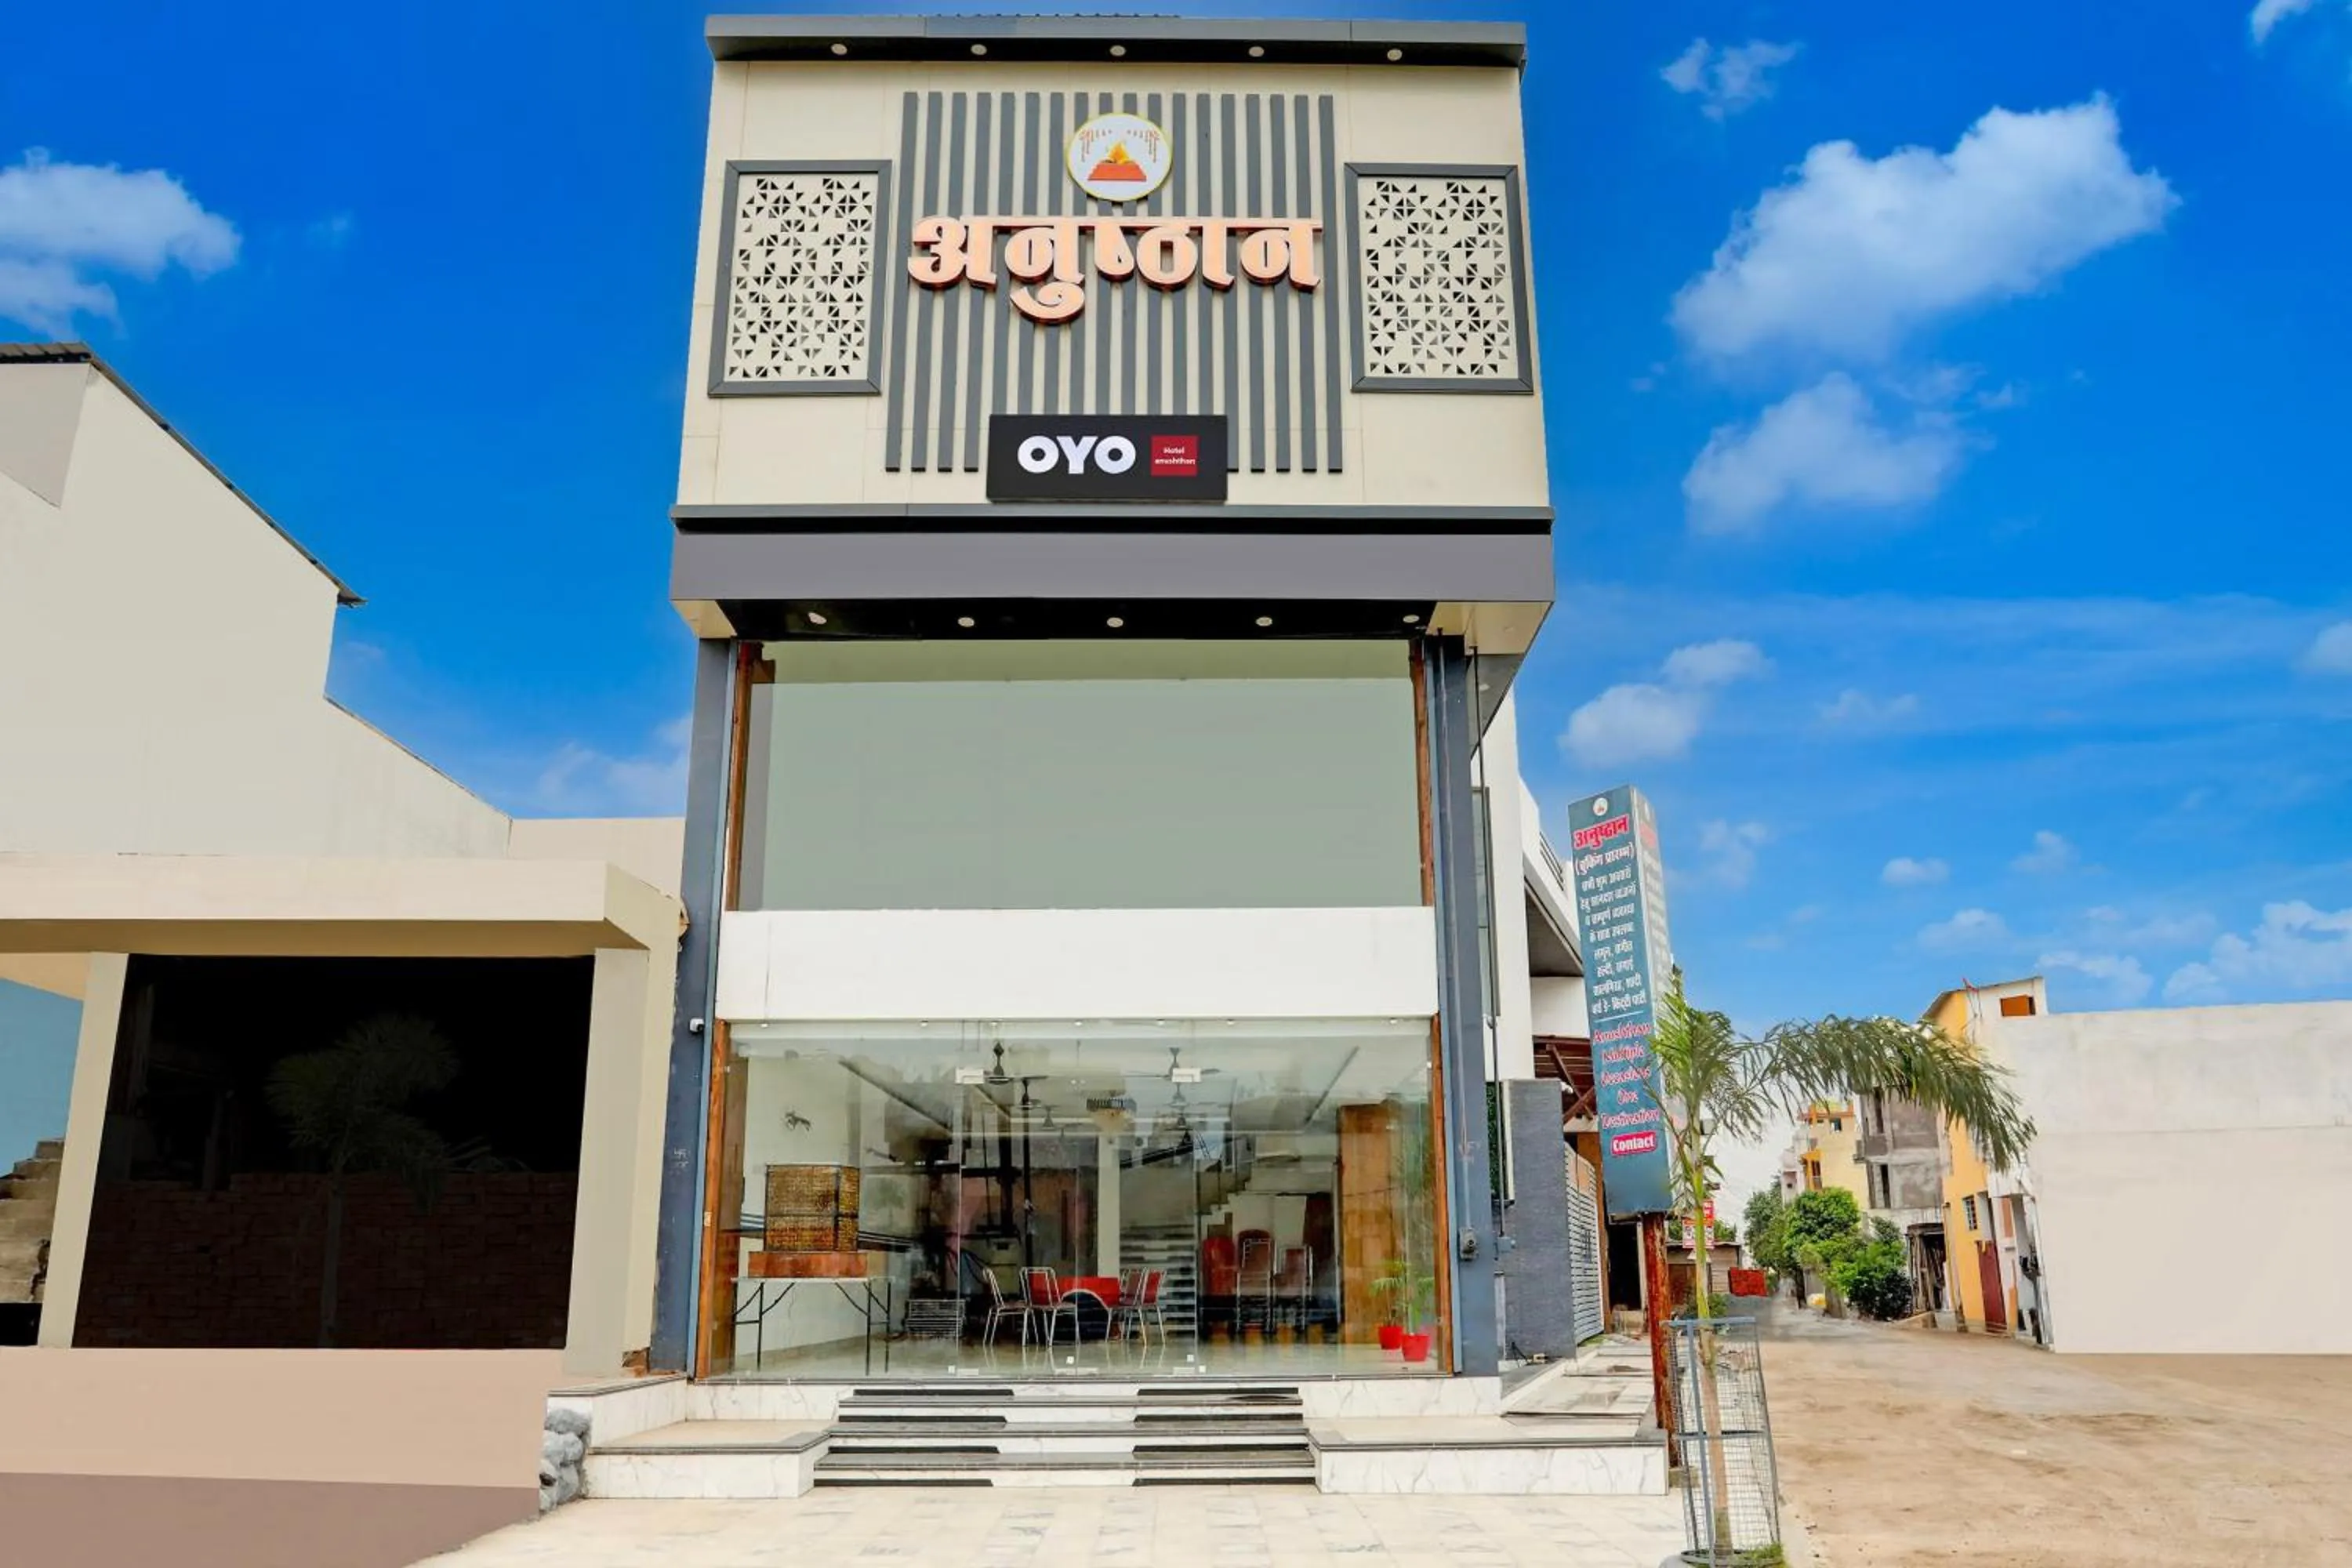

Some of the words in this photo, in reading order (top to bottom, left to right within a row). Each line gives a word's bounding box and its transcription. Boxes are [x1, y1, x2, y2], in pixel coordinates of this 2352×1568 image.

[908, 215, 1323, 325] अनुष्ठान
[1018, 435, 1136, 474] OYO
[1613, 1134, 1654, 1152] Contact
